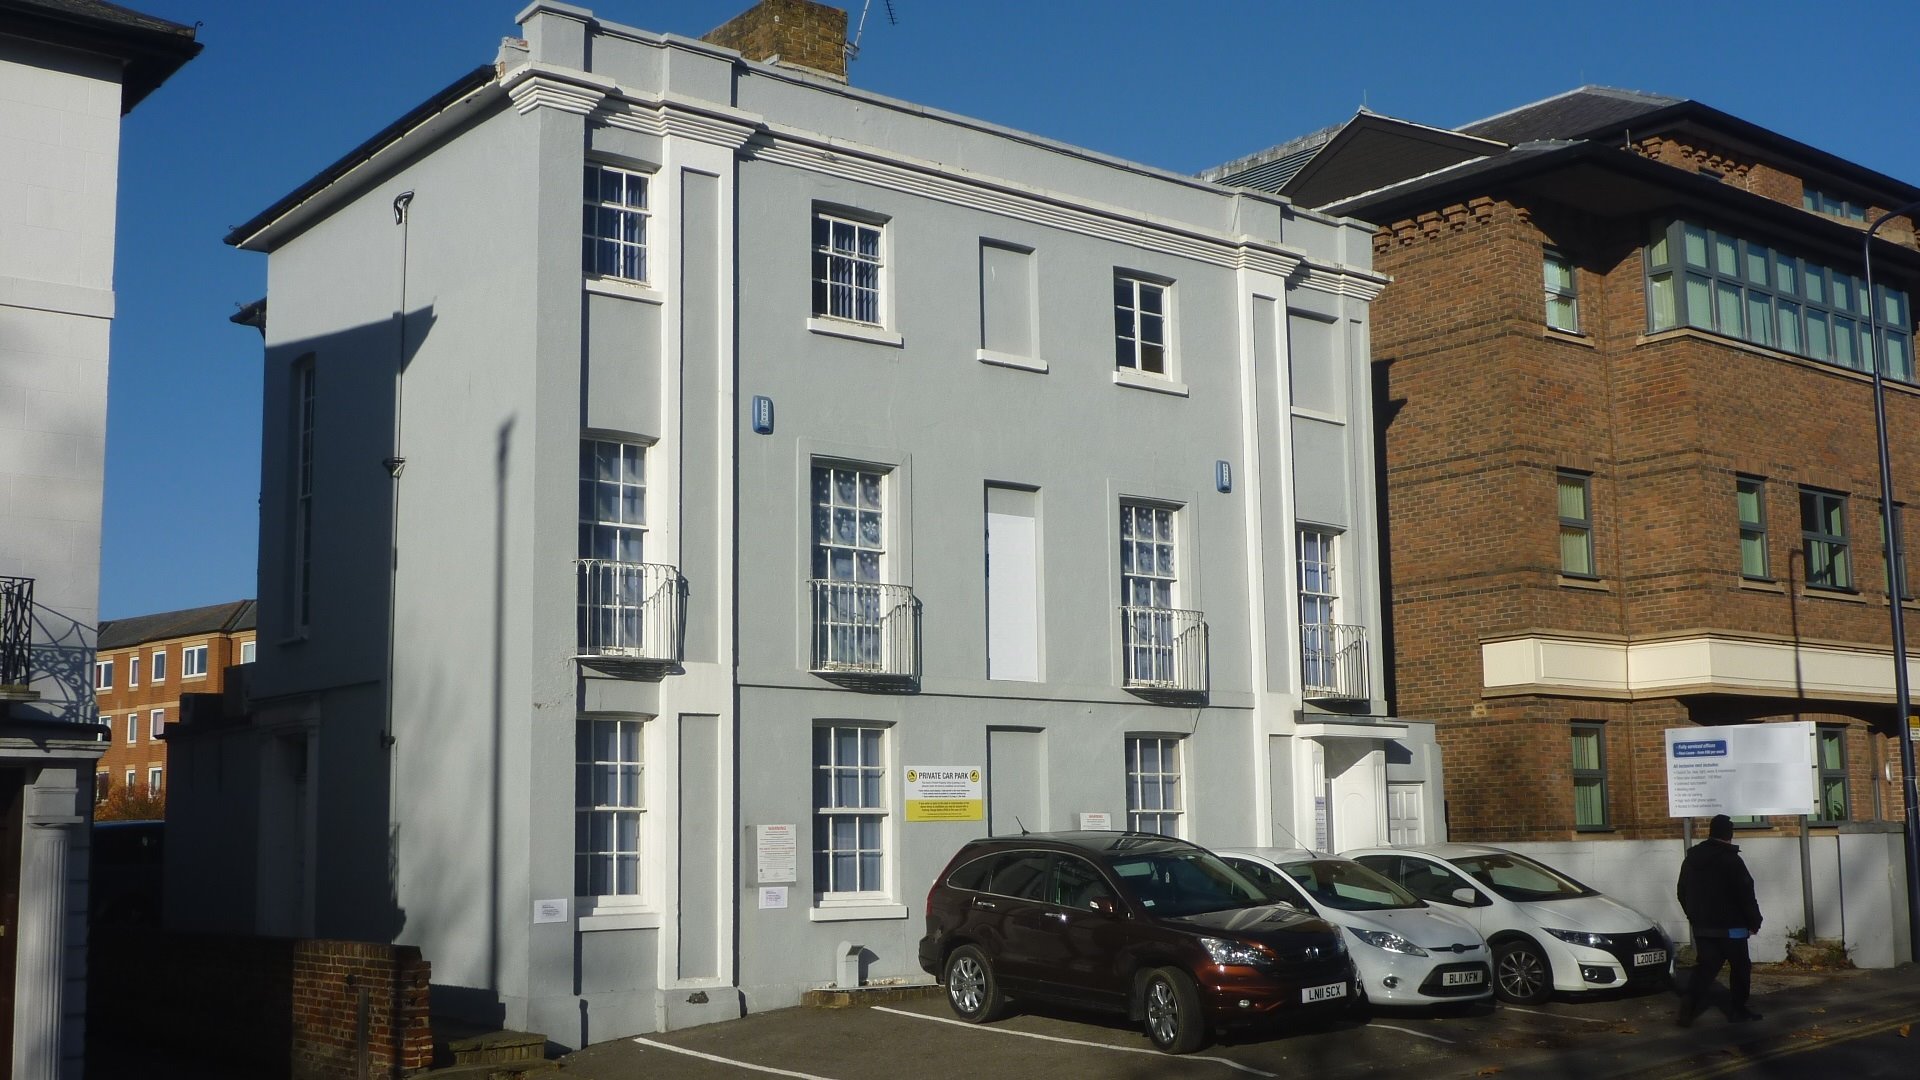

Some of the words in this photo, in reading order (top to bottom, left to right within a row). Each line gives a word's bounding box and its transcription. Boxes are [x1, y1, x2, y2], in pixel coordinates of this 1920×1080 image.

[918, 772, 941, 780] PRIVATE
[942, 772, 954, 780] CAR
[954, 772, 969, 780] PARK
[1636, 953, 1653, 965] L200
[1449, 973, 1463, 984] BL11
[1308, 987, 1324, 1001] LN11
[1325, 984, 1341, 998] SCX
